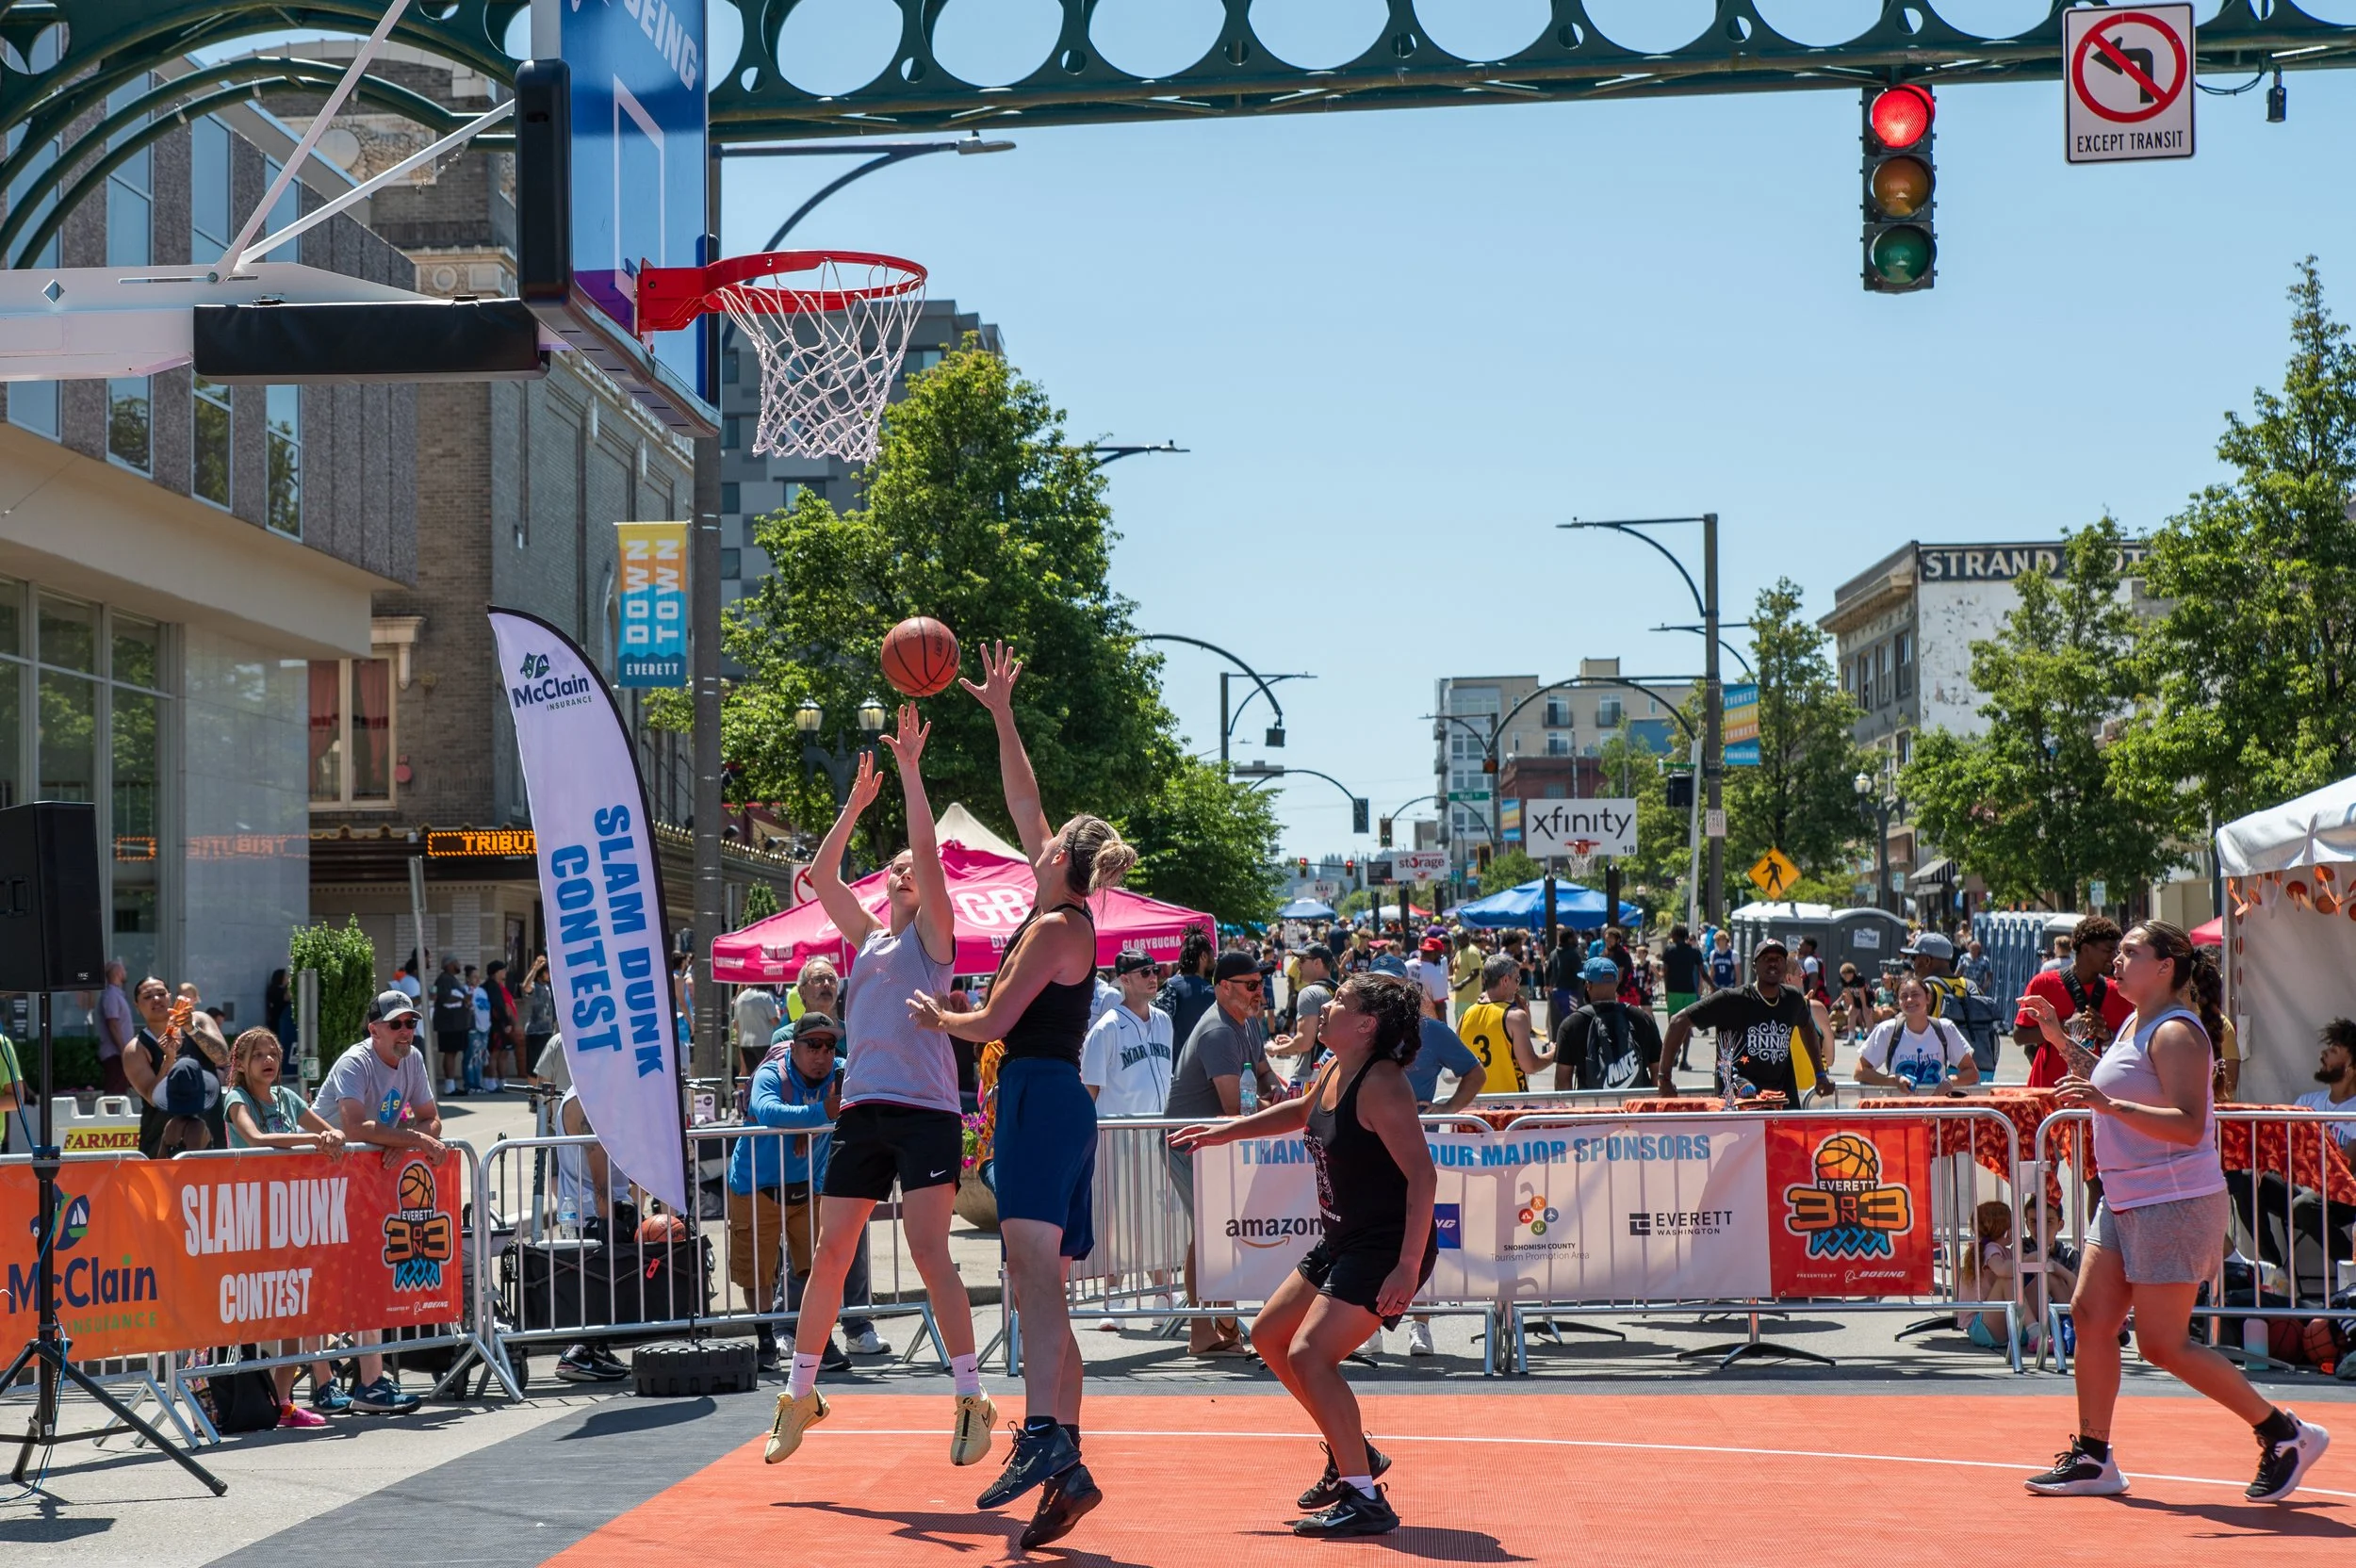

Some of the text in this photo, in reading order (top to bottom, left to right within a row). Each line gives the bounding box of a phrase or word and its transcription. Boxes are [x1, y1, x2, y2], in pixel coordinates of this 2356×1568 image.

[623, 0, 697, 91] EING
[2077, 130, 2184, 153] EXCEPT TRANSIT
[1925, 549, 2058, 578] STRAND
[626, 540, 649, 645] DOWN
[656, 540, 679, 645] TOWN
[626, 662, 679, 676] EVERETT
[512, 674, 590, 709] McClain
[547, 695, 593, 711] INSURANCE
[1531, 806, 1632, 841] xfinity
[462, 835, 538, 852] TRIBUT
[1622, 845, 1635, 854] 18
[1399, 858, 1445, 869] storage
[955, 889, 1032, 926] GB
[551, 844, 623, 1053] CONTEST
[594, 805, 664, 1078] SLAM DUNK
[1120, 1041, 1170, 1071] MARINER
[1472, 1035, 1492, 1068] 3
[1608, 1050, 1640, 1084] NIKE
[1481, 1140, 1567, 1167] MAJOR
[1574, 1134, 1711, 1163] SPONSORS
[1819, 1180, 1876, 1191] EVERETT
[181, 1177, 350, 1256] SLAM DUNK
[401, 1209, 434, 1220] EVERETT
[1656, 1210, 1733, 1227] EVERETT
[1791, 1189, 1837, 1230] 3
[1859, 1188, 1908, 1230] 3
[385, 1218, 413, 1262] 3
[423, 1216, 450, 1260] 3
[1225, 1217, 1322, 1237] amazon
[1657, 1228, 1721, 1236] WASHINGTON
[1490, 1250, 1590, 1263] Tourism Promotion Area
[1503, 1242, 1576, 1251] SNOHOMISH COUNTY
[220, 1267, 313, 1324] CONTEST
